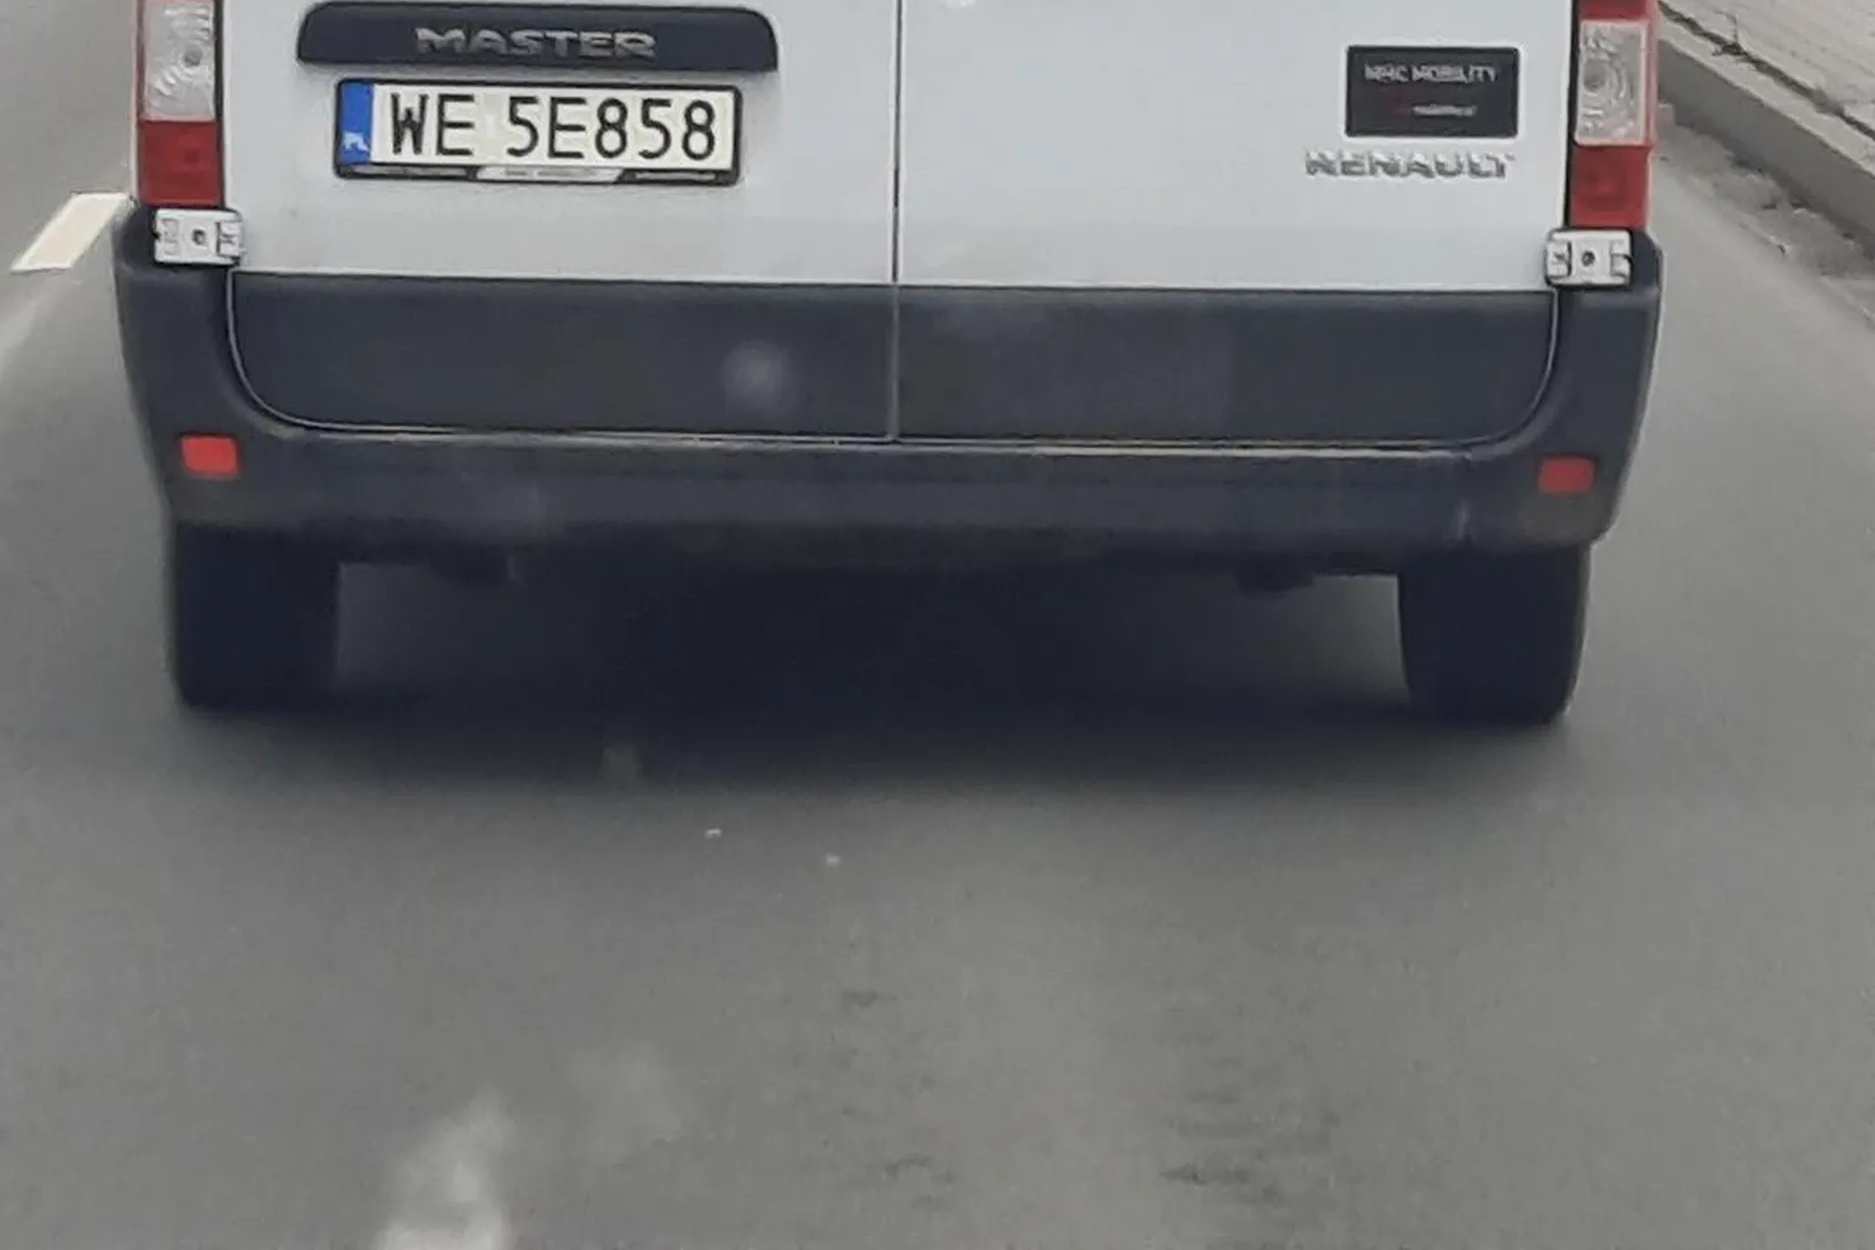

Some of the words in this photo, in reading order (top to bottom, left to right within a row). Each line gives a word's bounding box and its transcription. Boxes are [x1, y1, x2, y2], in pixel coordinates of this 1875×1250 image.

[414, 27, 656, 58] MASTER
[390, 92, 476, 157] WE
[505, 95, 717, 161] 5E858
[1305, 149, 1515, 179] RENAULT
